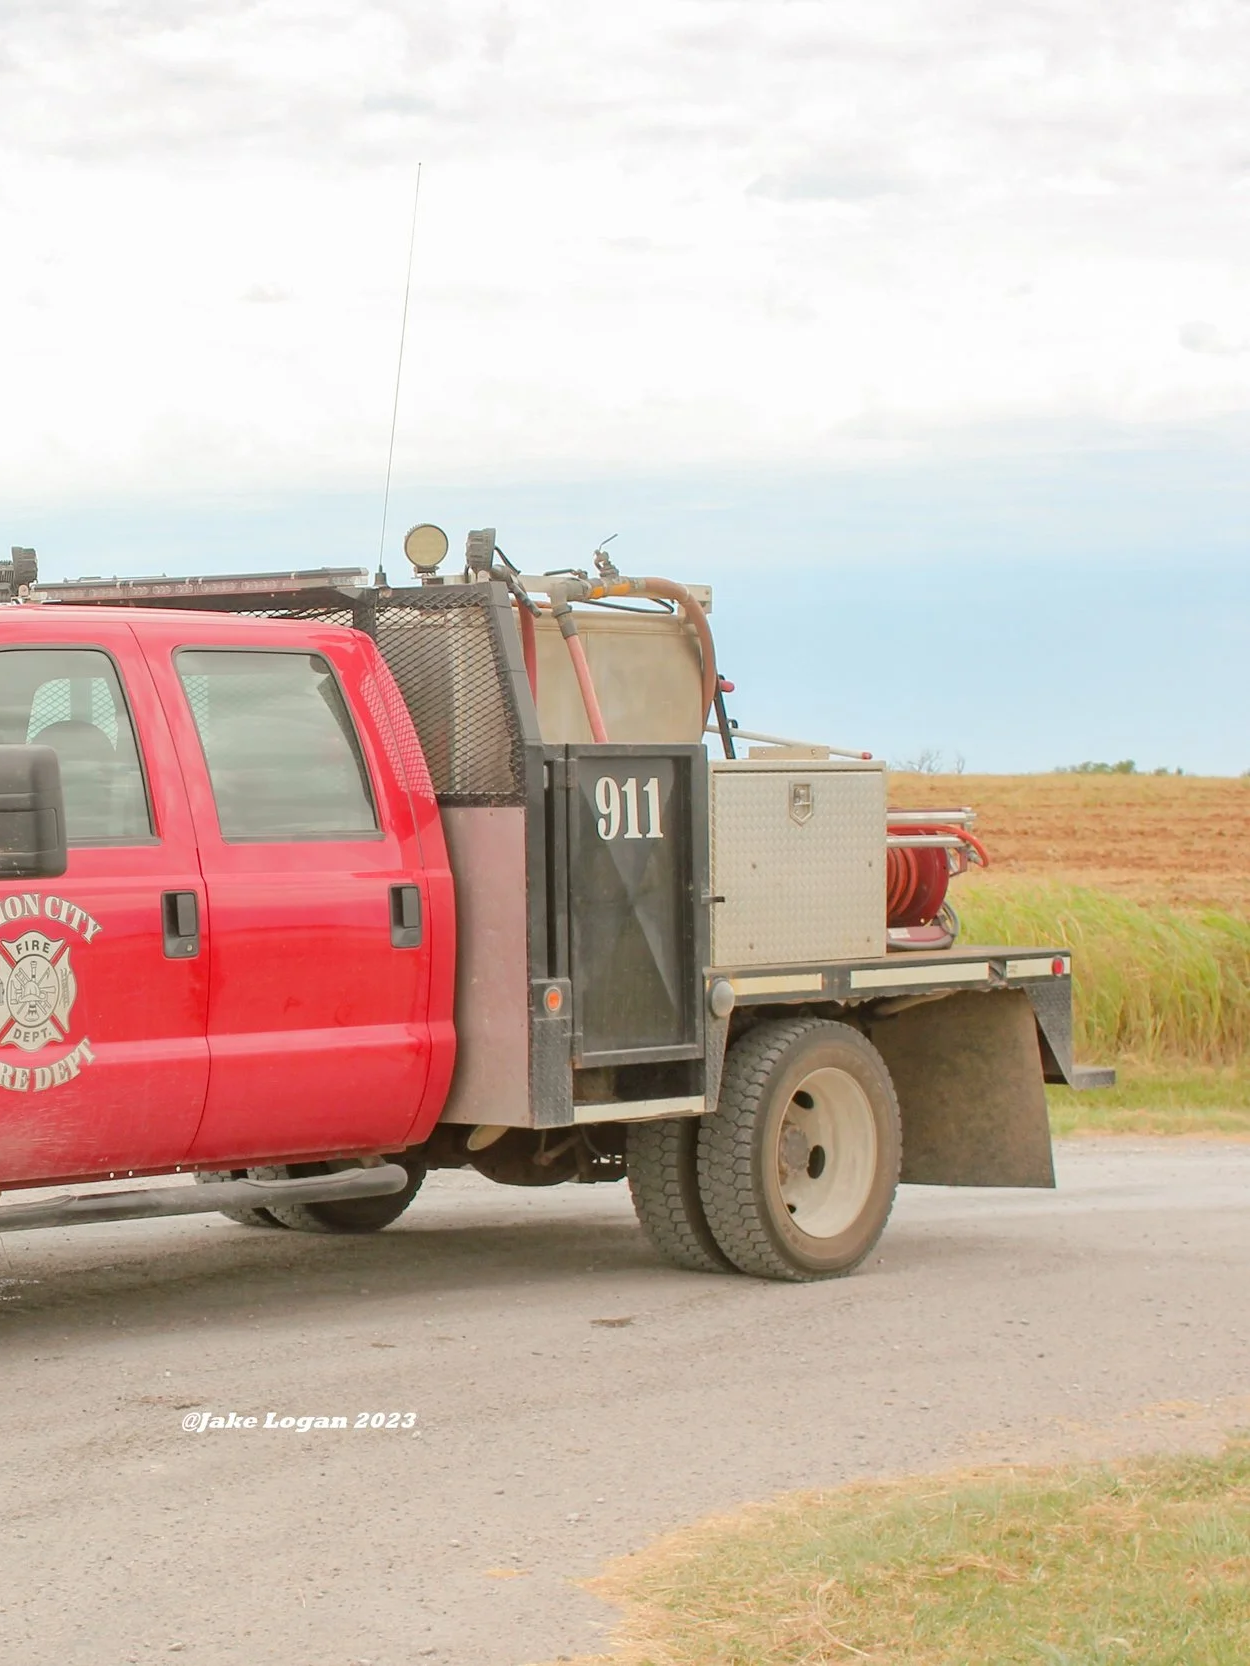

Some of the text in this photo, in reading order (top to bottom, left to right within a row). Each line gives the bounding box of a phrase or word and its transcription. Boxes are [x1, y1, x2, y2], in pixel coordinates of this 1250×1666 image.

[594, 776, 664, 841] 911
[44, 895, 103, 945] CITY
[15, 939, 51, 955] FIRE
[33, 1038, 95, 1092] DEPT
